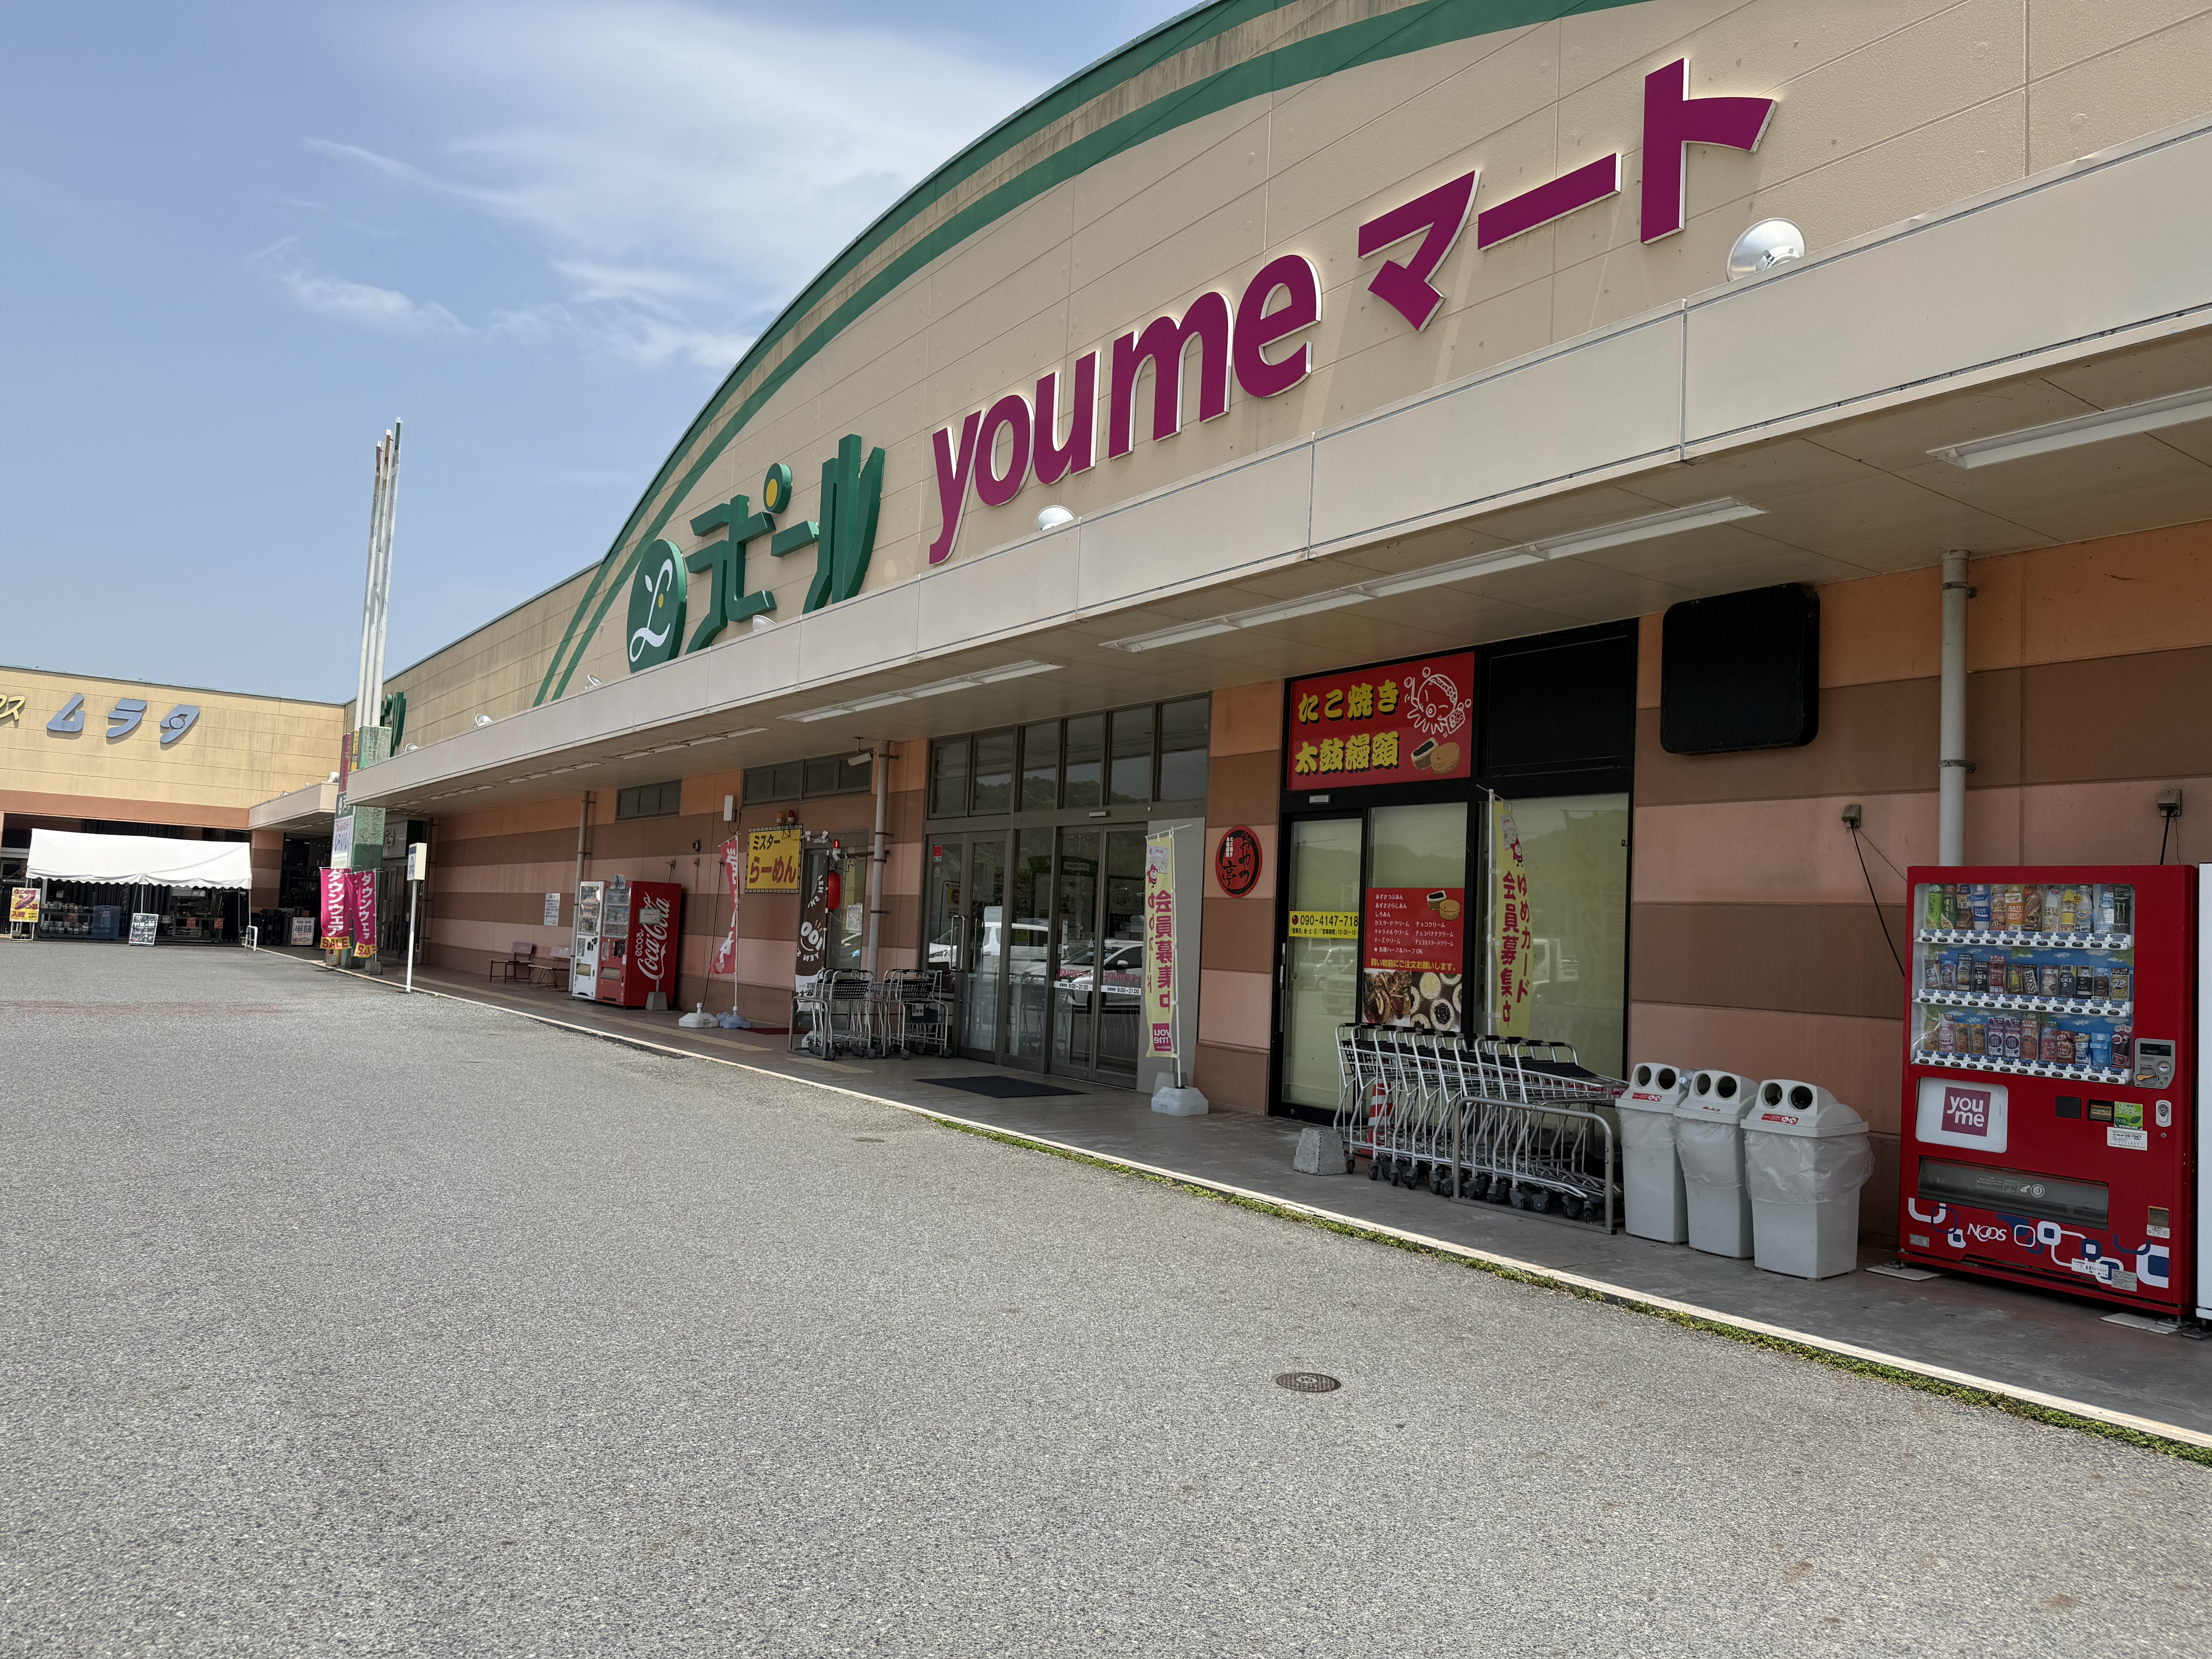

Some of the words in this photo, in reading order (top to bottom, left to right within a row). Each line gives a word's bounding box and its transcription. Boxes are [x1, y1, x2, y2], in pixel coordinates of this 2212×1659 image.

[929, 254, 1321, 565] youme
[1358, 58, 1778, 331] マート
[1298, 679, 1400, 723] たこ焼き
[46, 693, 200, 743] ムラタ
[753, 834, 781, 850] ミスター
[749, 855, 797, 884] らーめん
[322, 938, 348, 948] SALE
[1500, 870, 1519, 1030] 会員募集中
[1516, 873, 1530, 1003] ゆめカード
[1371, 958, 1456, 971] 買い物前にご注文お願いします。
[2025, 972, 2037, 993] BOSS
[1947, 1096, 1984, 1114] you
[1954, 1111, 1985, 1127] me
